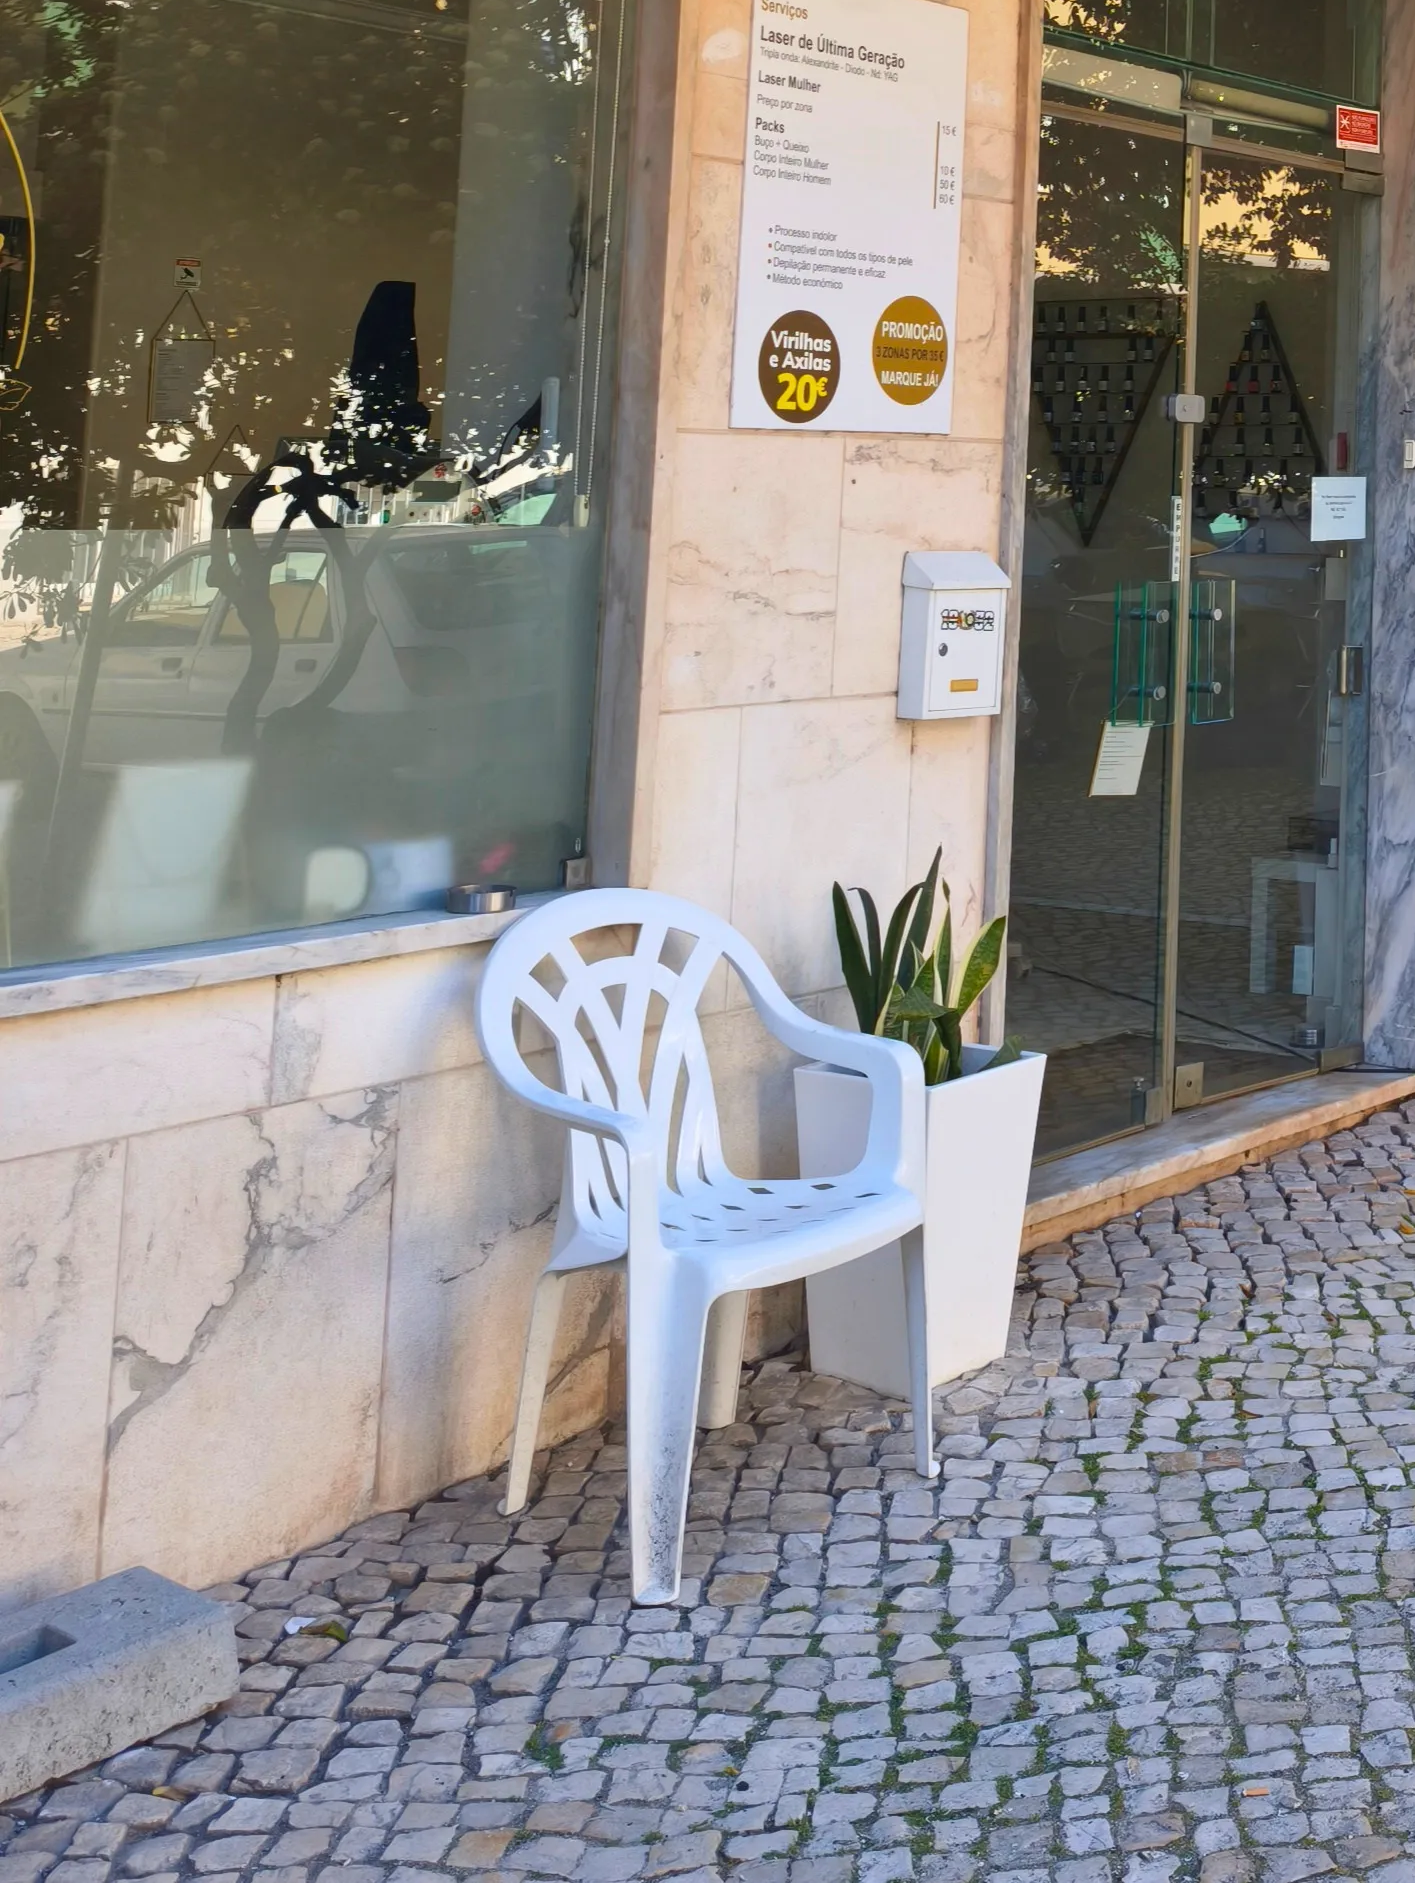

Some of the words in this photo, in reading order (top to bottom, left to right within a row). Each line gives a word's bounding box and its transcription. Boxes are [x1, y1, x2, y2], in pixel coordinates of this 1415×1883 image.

[760, 25, 795, 46] Laser
[798, 34, 813, 50] de
[817, 33, 854, 58] Última
[858, 46, 905, 70] Geração
[758, 70, 786, 86] Laser
[788, 75, 821, 93] Mulher
[757, 94, 779, 109] Preço
[780, 101, 793, 111] por
[794, 103, 813, 113] zona
[755, 117, 785, 133] Packs
[942, 125, 951, 136] 15
[952, 126, 957, 136] €
[755, 135, 774, 150] Buço
[754, 150, 777, 163] Corpo
[779, 154, 802, 167] Inteiro
[804, 157, 829, 171] Mulher
[753, 165, 776, 178] Corpo
[803, 172, 831, 186] Homem
[774, 225, 810, 239] Processo
[812, 230, 837, 242] indolor
[818, 248, 834, 257] com
[836, 249, 856, 260] todos
[858, 253, 867, 261] os
[887, 255, 896, 264] de
[773, 256, 811, 272] Depilação
[813, 263, 856, 276] permanente
[772, 273, 801, 286] Método
[771, 330, 831, 352] Virilhas
[882, 321, 943, 344] PROMOÇÃO
[769, 354, 779, 368] e
[782, 351, 831, 372] Axilas
[883, 347, 909, 360] ZONAS
[912, 348, 928, 361] POR
[881, 370, 922, 386] MARQUE
